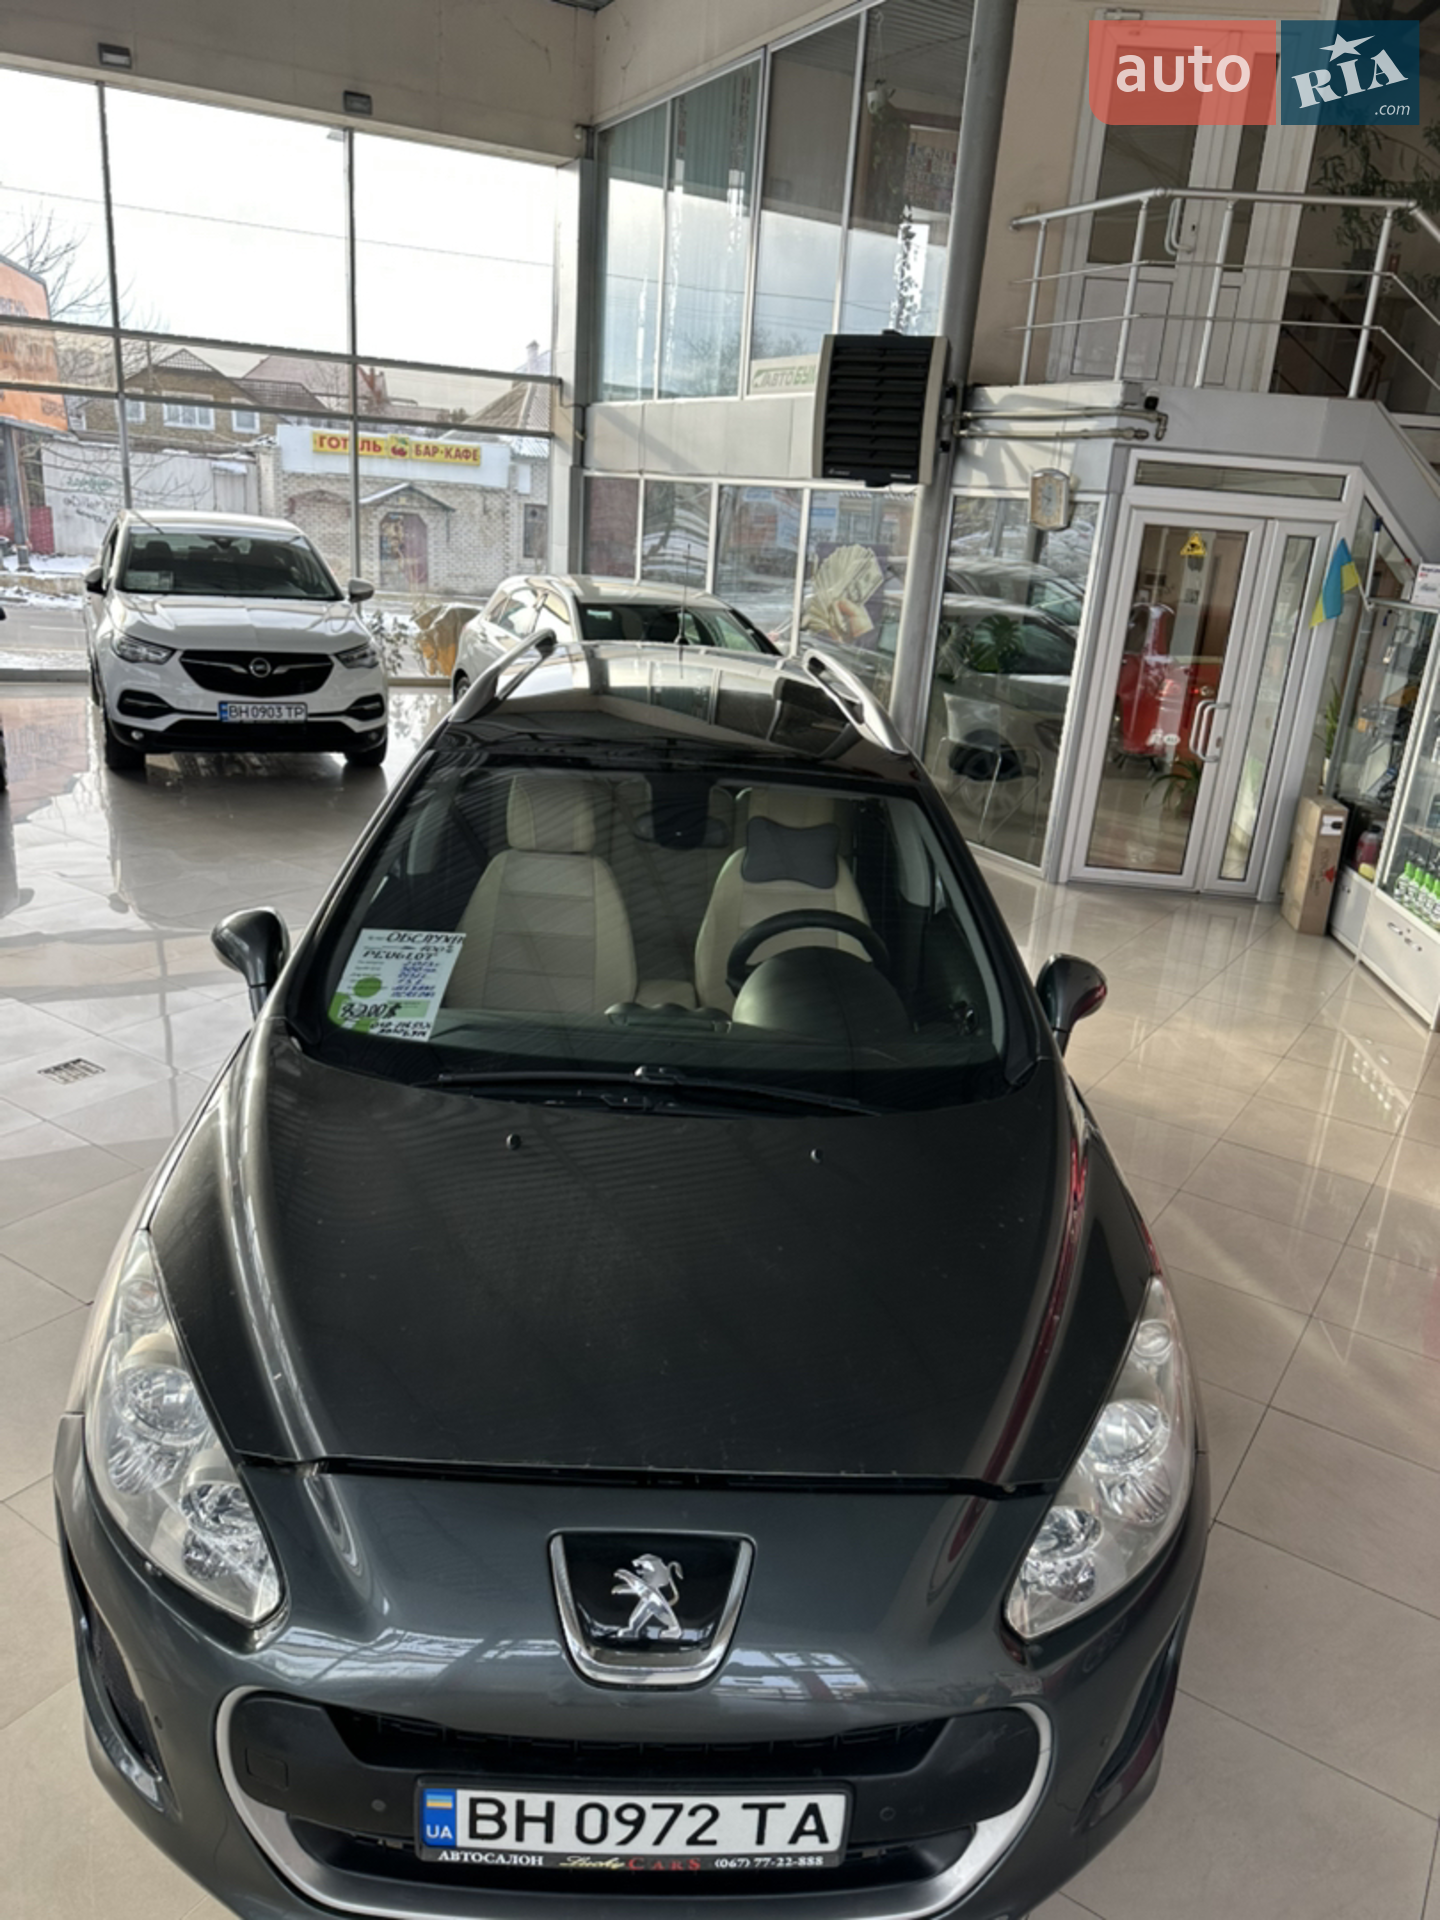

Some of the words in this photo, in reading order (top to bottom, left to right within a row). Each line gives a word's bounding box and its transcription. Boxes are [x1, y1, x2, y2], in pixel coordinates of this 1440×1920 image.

[318, 435, 382, 453] ГОТЛЬ
[229, 705, 249, 718] BH
[251, 706, 283, 718] 0903
[286, 706, 304, 718] TP
[468, 1796, 555, 1844] BH
[575, 1801, 720, 1847] 0972
[742, 1801, 830, 1847] TA
[426, 1824, 453, 1839] UA
[438, 1850, 544, 1867] АВТОСАЛОН
[714, 1857, 751, 1869] (067)
[753, 1855, 824, 1868] 77-22-888
